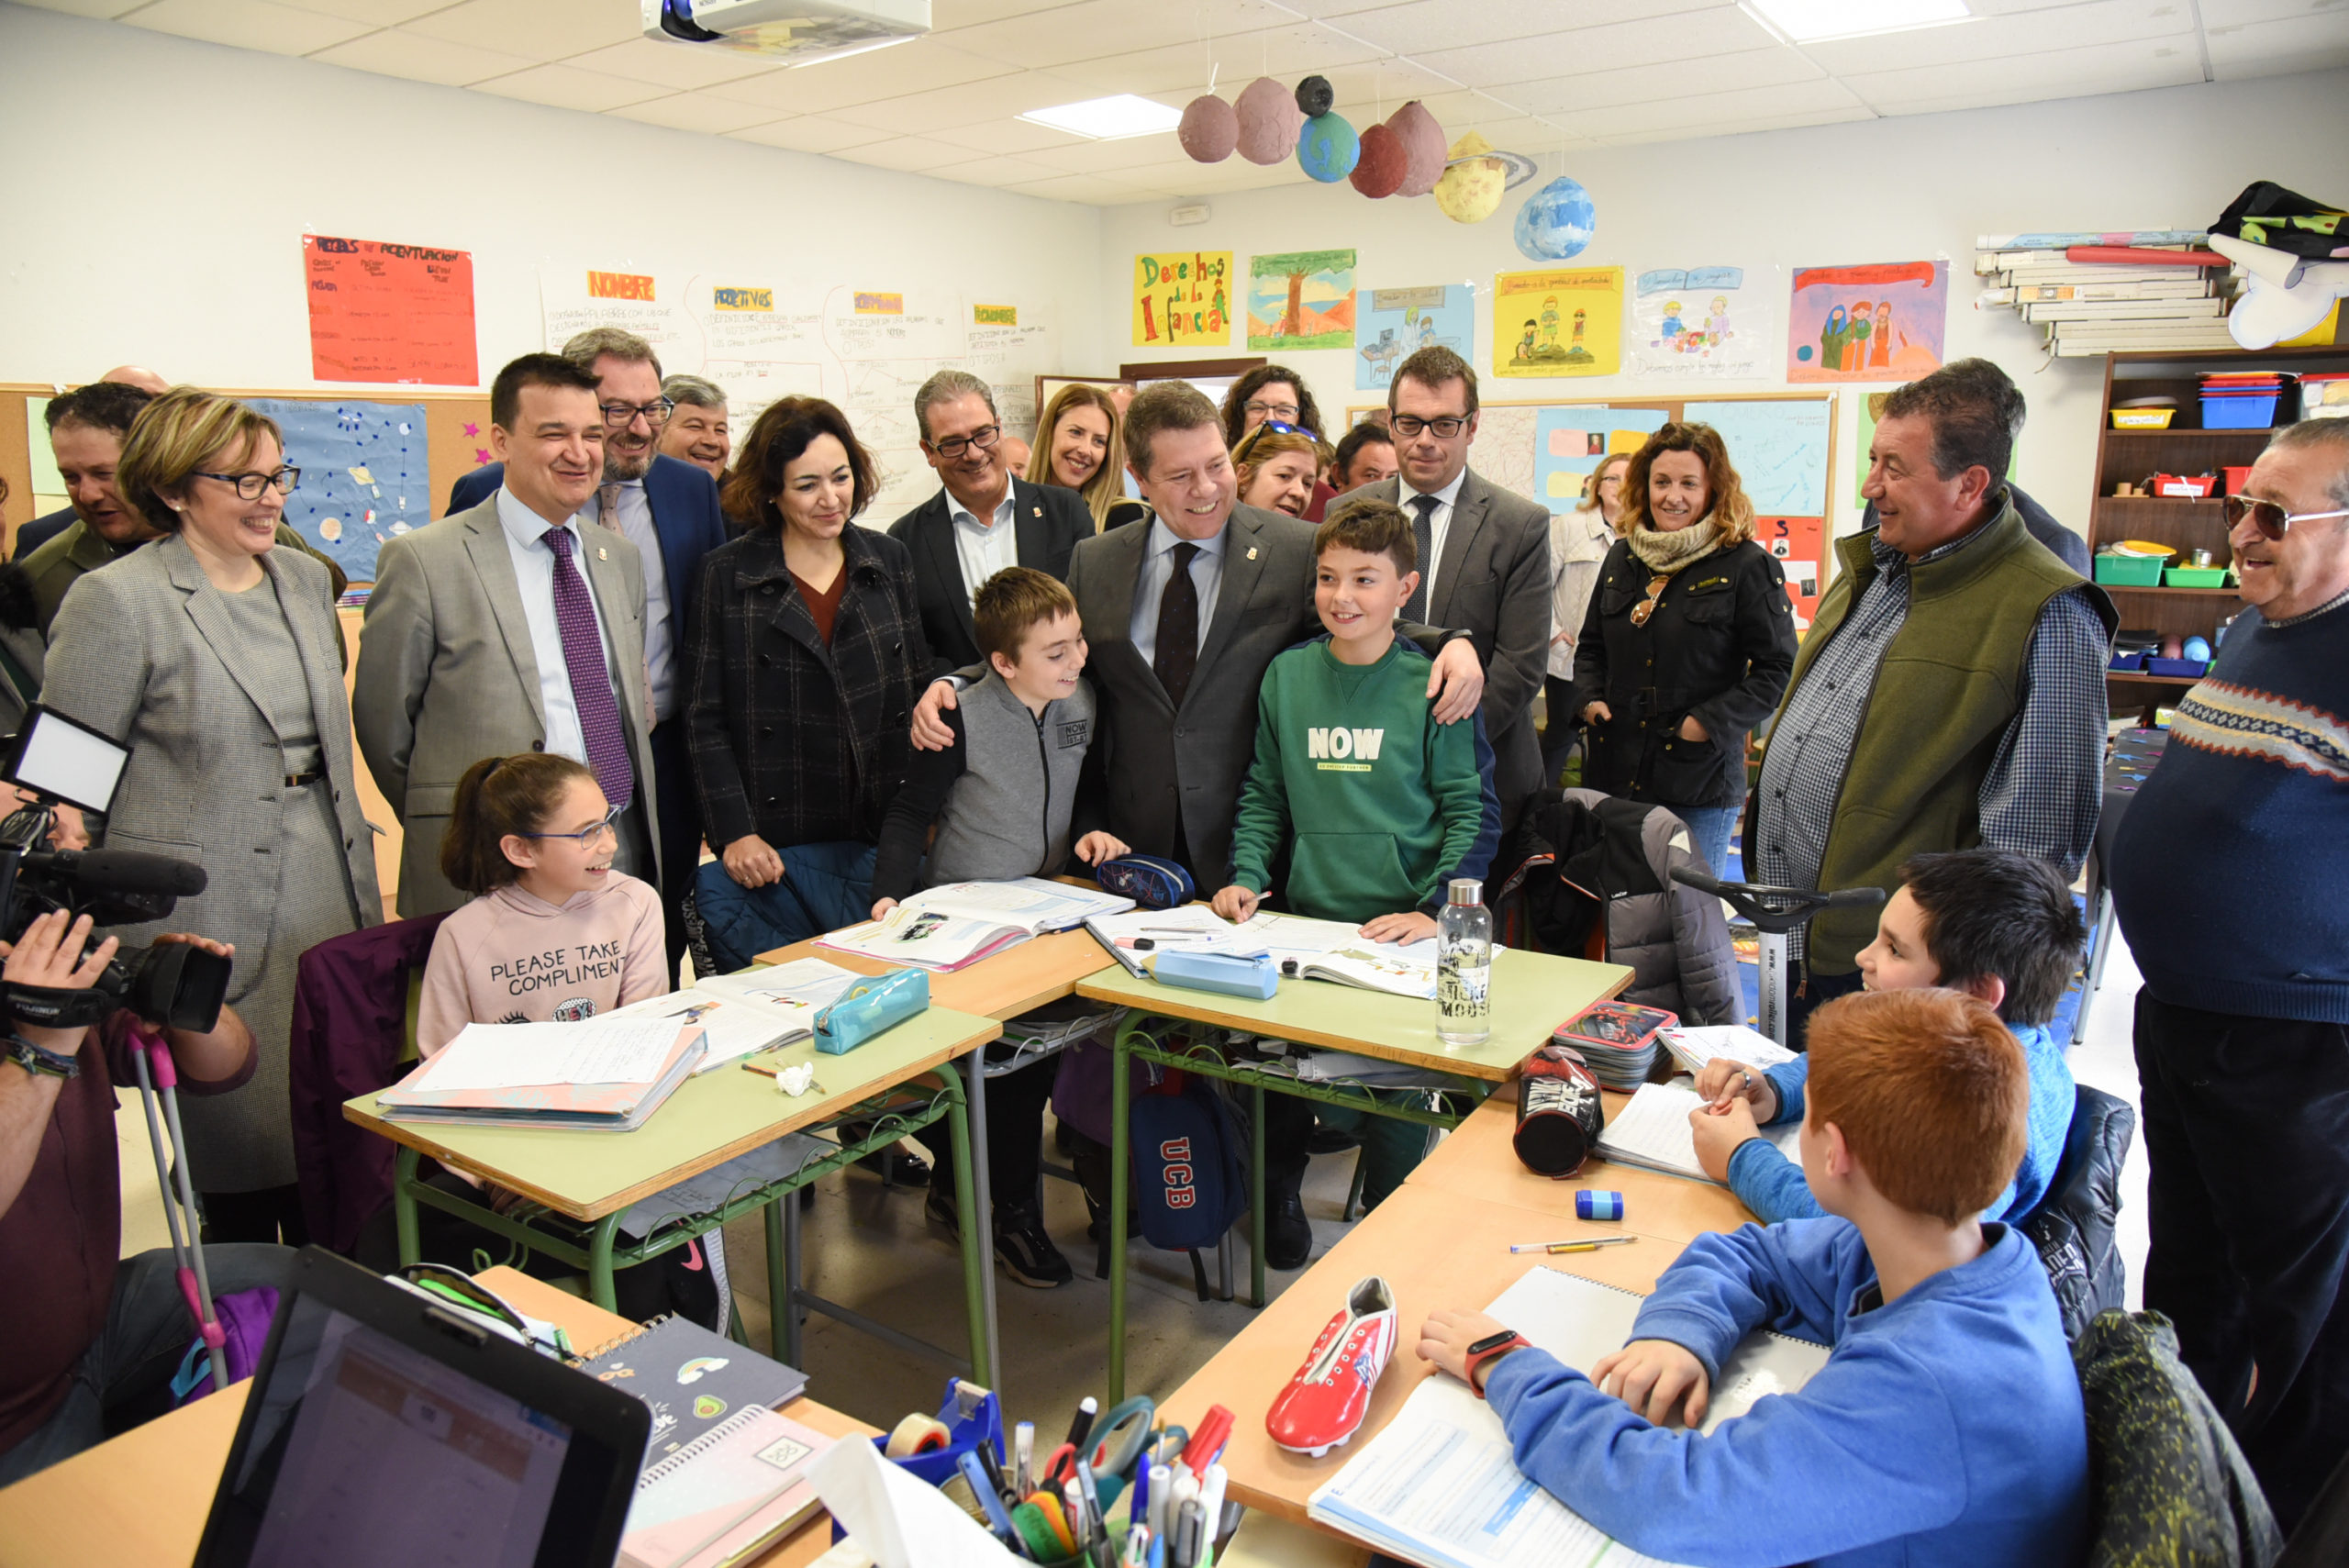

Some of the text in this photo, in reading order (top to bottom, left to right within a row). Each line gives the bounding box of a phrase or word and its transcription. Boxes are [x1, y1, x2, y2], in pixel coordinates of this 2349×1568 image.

[588, 271, 655, 302] NOMBRE
[1141, 251, 1226, 288] Derechos
[1174, 285, 1186, 303] de
[1141, 294, 1222, 343] Infancia
[1065, 721, 1087, 735] NOW
[1308, 727, 1385, 760] NOW
[492, 940, 621, 982] PLEASE TAKE
[1160, 1136, 1197, 1210] UCB
